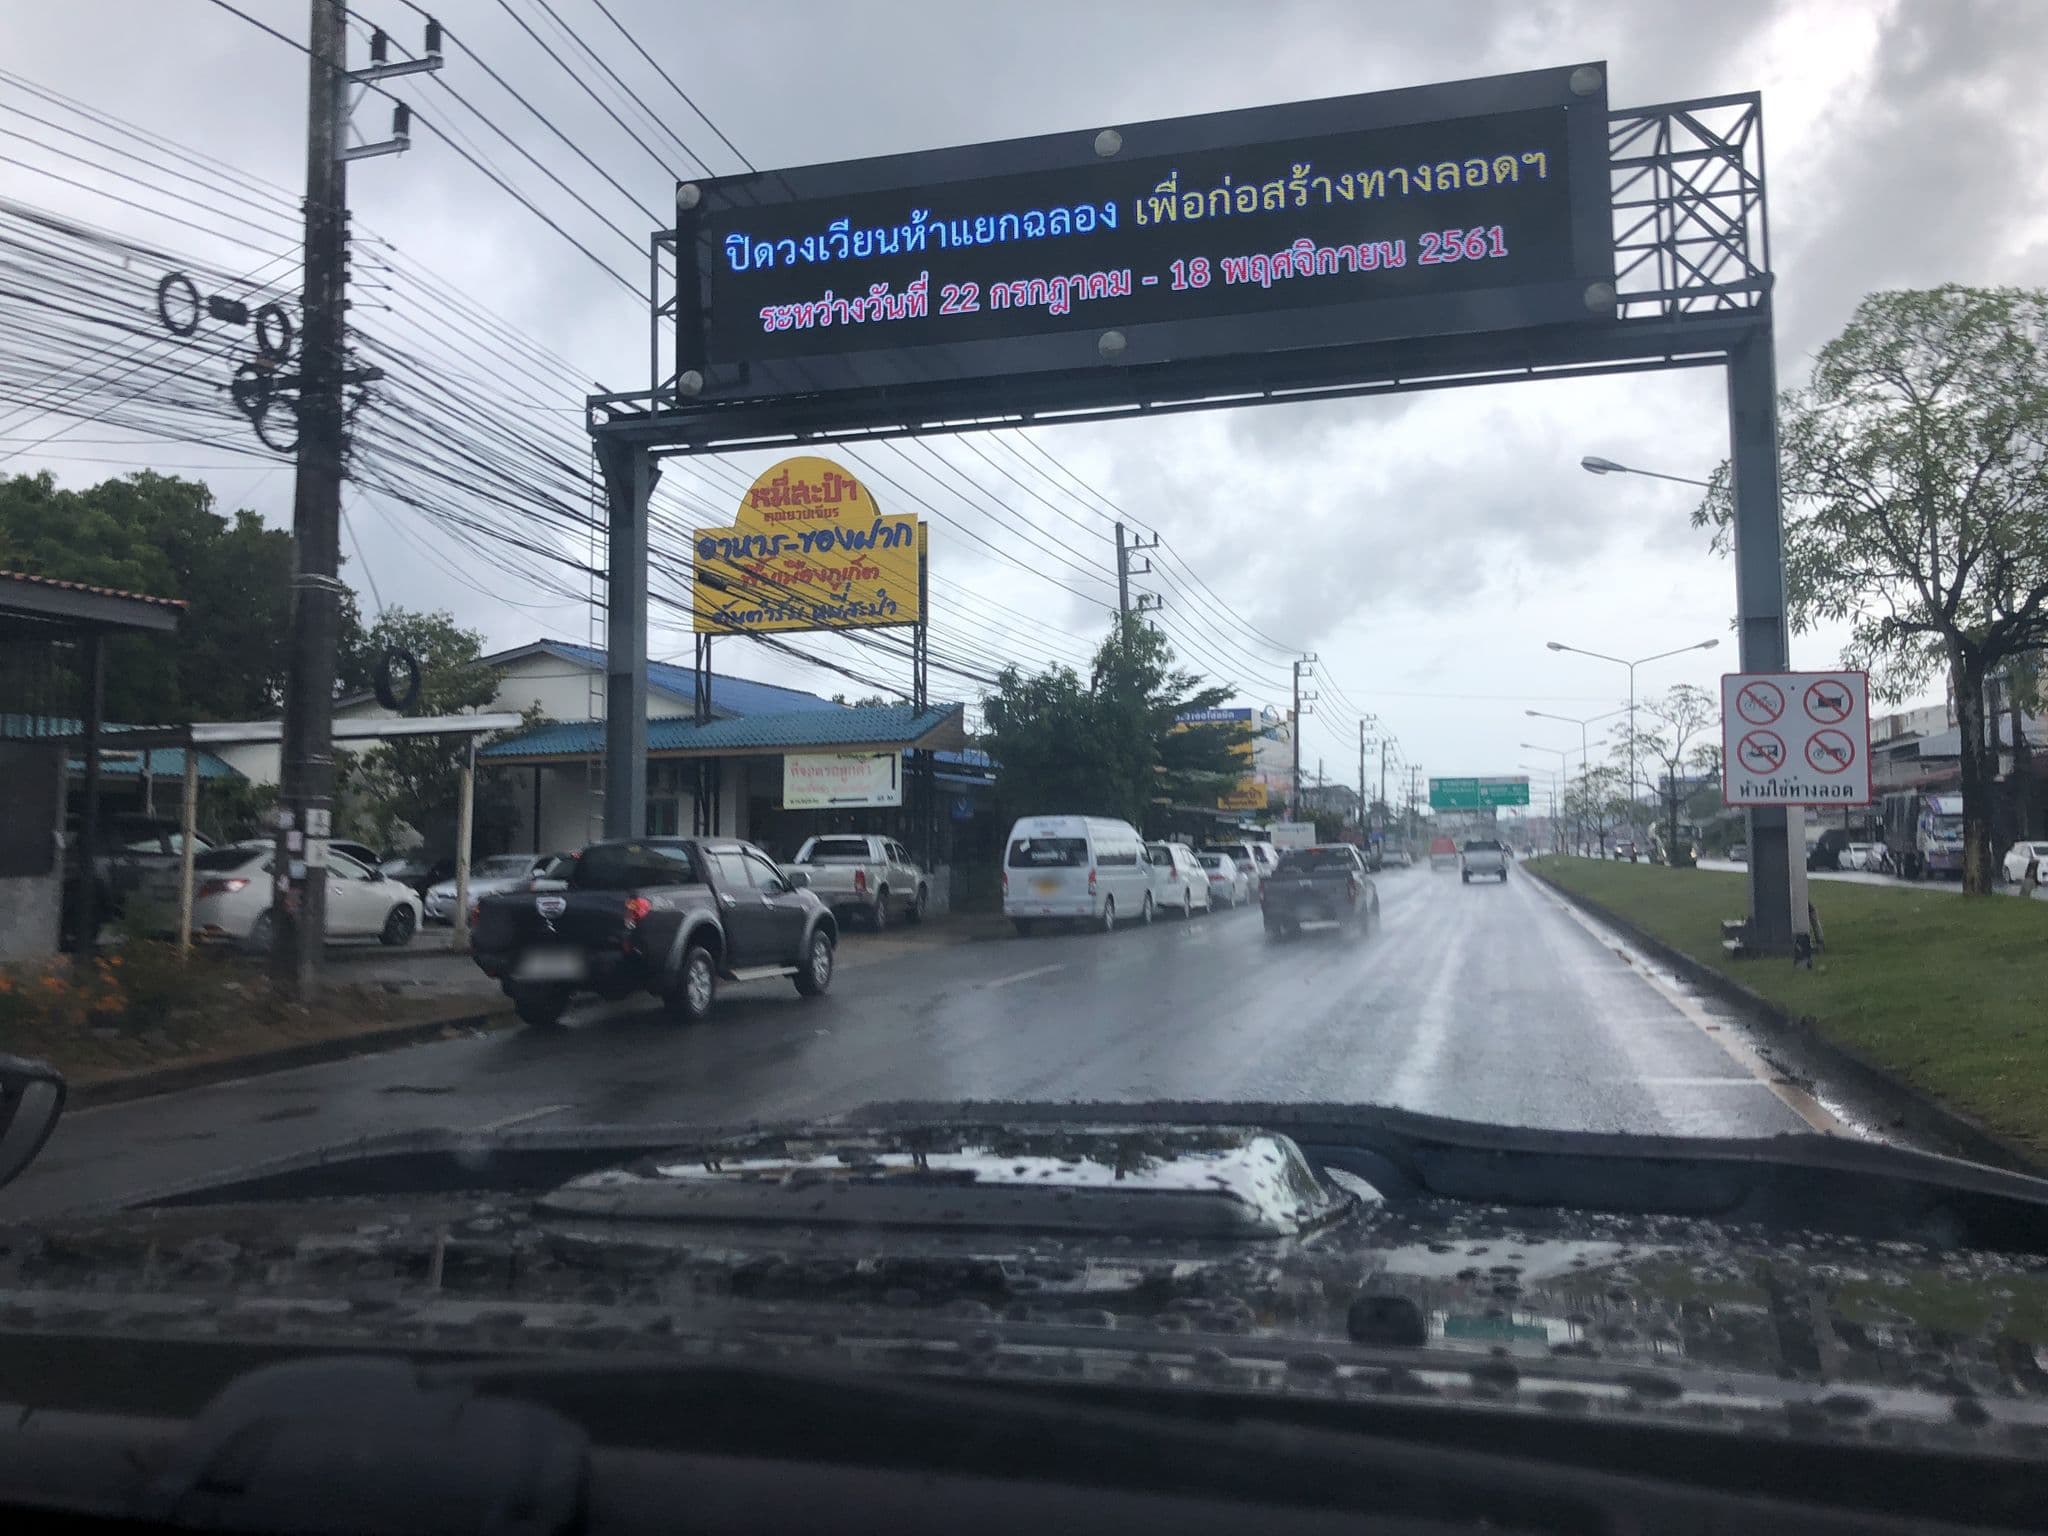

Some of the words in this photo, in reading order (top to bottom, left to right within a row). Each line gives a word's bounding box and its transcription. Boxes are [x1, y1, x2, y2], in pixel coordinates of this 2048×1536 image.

[725, 201, 1119, 271] ปิดวงเวียนห้าแยกฉลอง
[1136, 150, 1547, 225] เพื่อก่อสร้างทางลอดฯ
[759, 271, 928, 333] ระหว่างวันที่
[939, 283, 981, 315] 22
[990, 268, 1132, 316] กรกฎาคม
[1142, 275, 1158, 286] -
[1170, 257, 1211, 291] 18
[1223, 238, 1406, 288] พฤศจิกายน
[1418, 225, 1508, 265] 2561
[1740, 778, 1853, 798] ห้ามใช้ทางลอด
